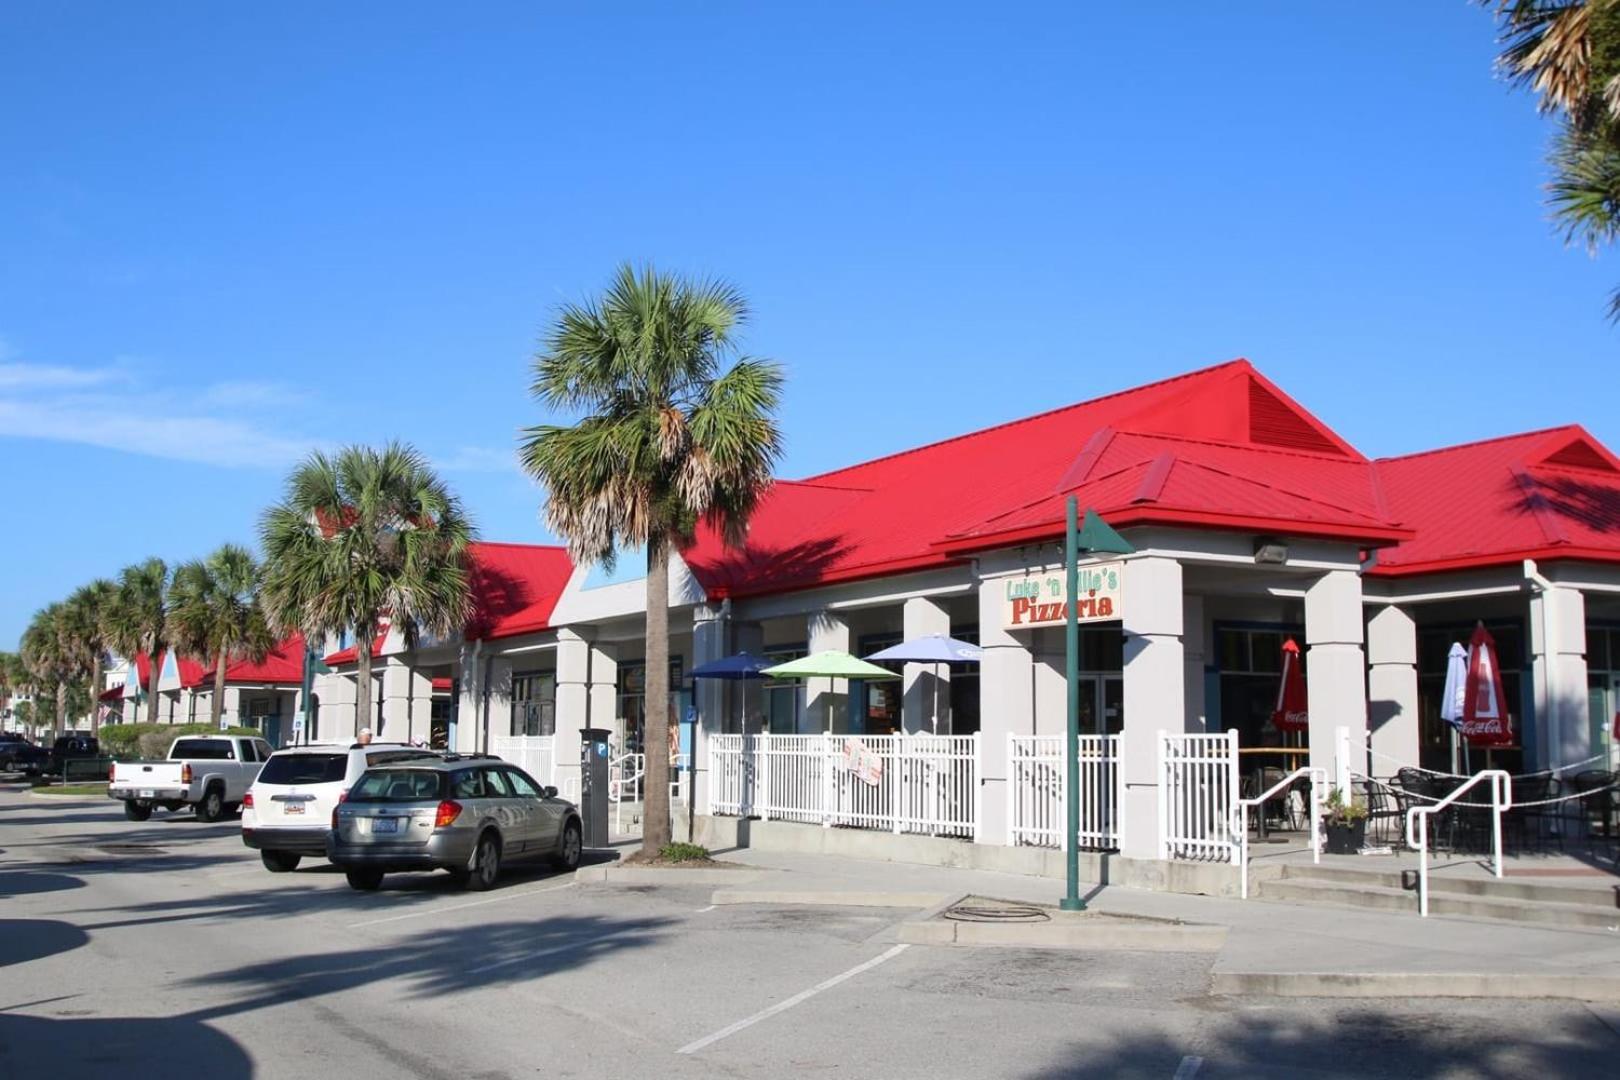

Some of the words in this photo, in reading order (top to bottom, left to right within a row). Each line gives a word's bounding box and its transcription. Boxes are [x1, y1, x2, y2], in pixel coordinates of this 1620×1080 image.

[1006, 579, 1040, 601] Luke
[1067, 567, 1118, 593] llie's
[598, 743, 606, 755] P
